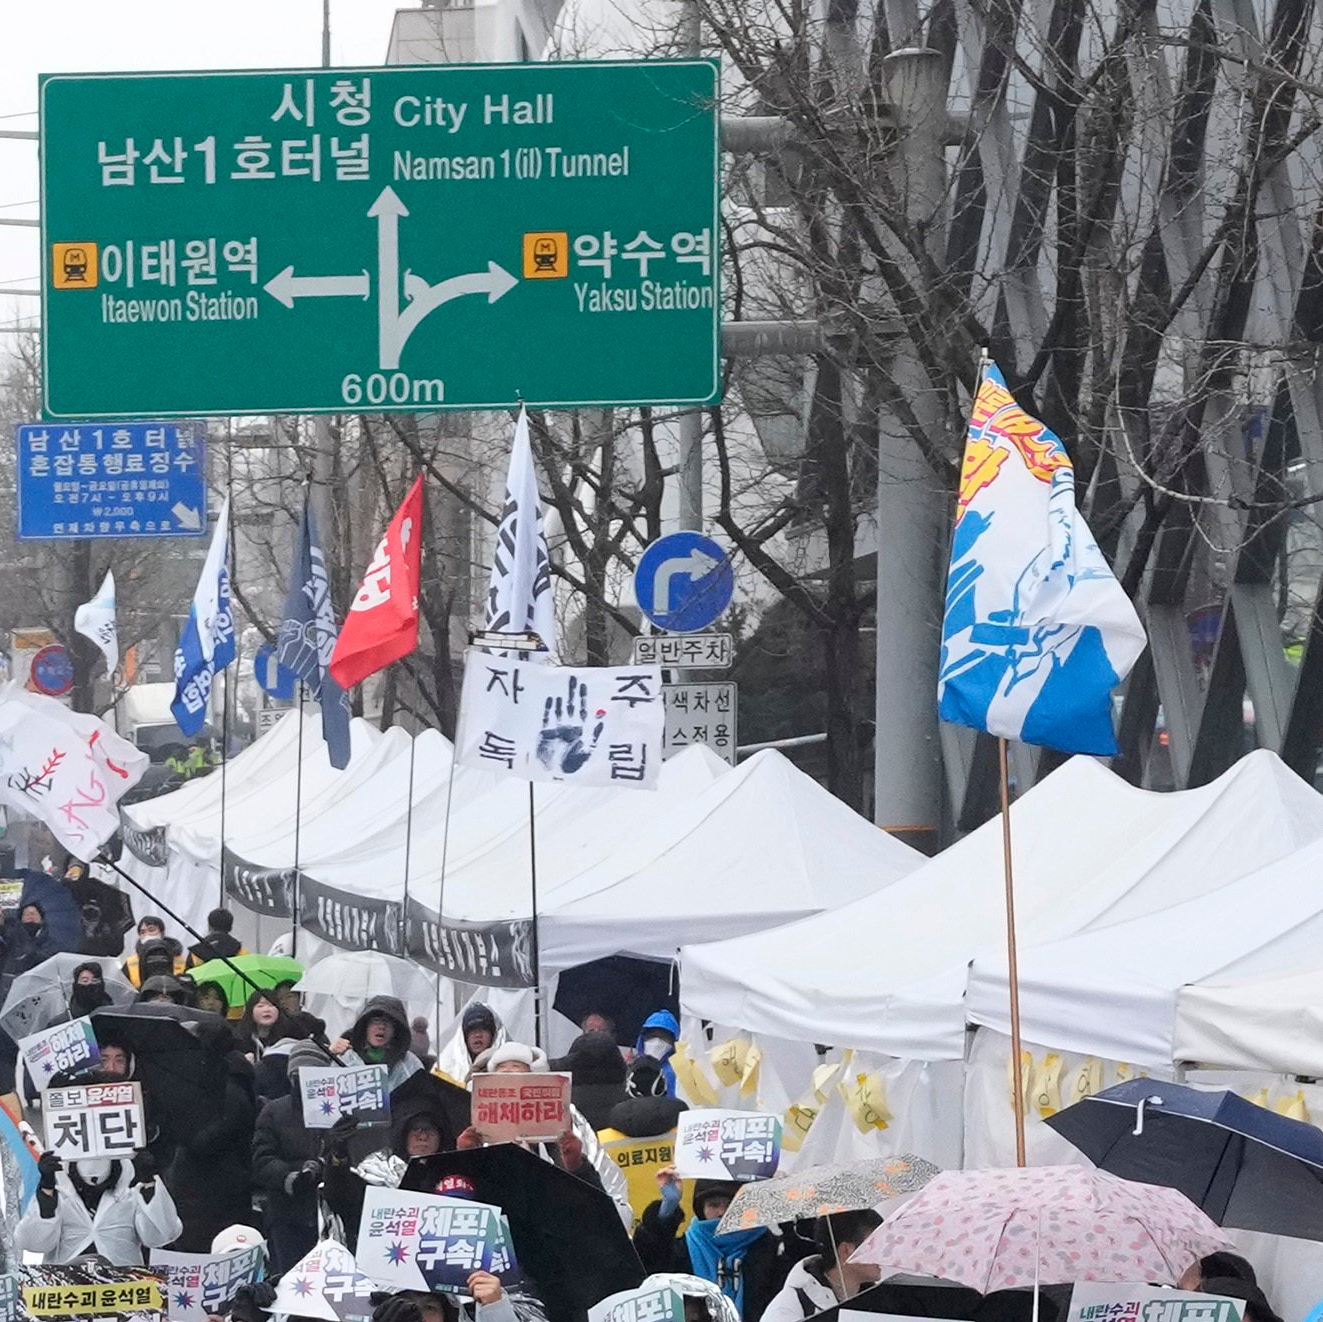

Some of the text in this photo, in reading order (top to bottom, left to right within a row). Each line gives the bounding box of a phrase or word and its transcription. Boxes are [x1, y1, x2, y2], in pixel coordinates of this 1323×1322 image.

[271, 79, 373, 127] 시청
[394, 95, 554, 133] City Hall
[97, 132, 372, 185] 남산1호터널
[394, 147, 629, 182] Namsan 1(il) Tunnel
[101, 237, 259, 289] 이태원역
[573, 228, 713, 276] 약수역
[101, 290, 258, 323] Itaewon Station
[574, 279, 714, 313] Yaksu Station
[340, 373, 445, 405] 600m
[29, 452, 195, 477] 혼잡통행료징수
[639, 640, 727, 664] 일반주차
[87, 1085, 133, 1104] 윤석열
[336, 1066, 383, 1094] 체포!
[477, 1088, 517, 1098] 내란동조
[338, 1090, 387, 1114] 구속!
[477, 1101, 563, 1124] 해체하라
[54, 1109, 138, 1152] 처단
[722, 1115, 776, 1142] 체포!
[721, 1138, 776, 1166] 구속!
[419, 1203, 492, 1240] 체포!
[30, 1286, 152, 1311] 내란수괴 윤석열
